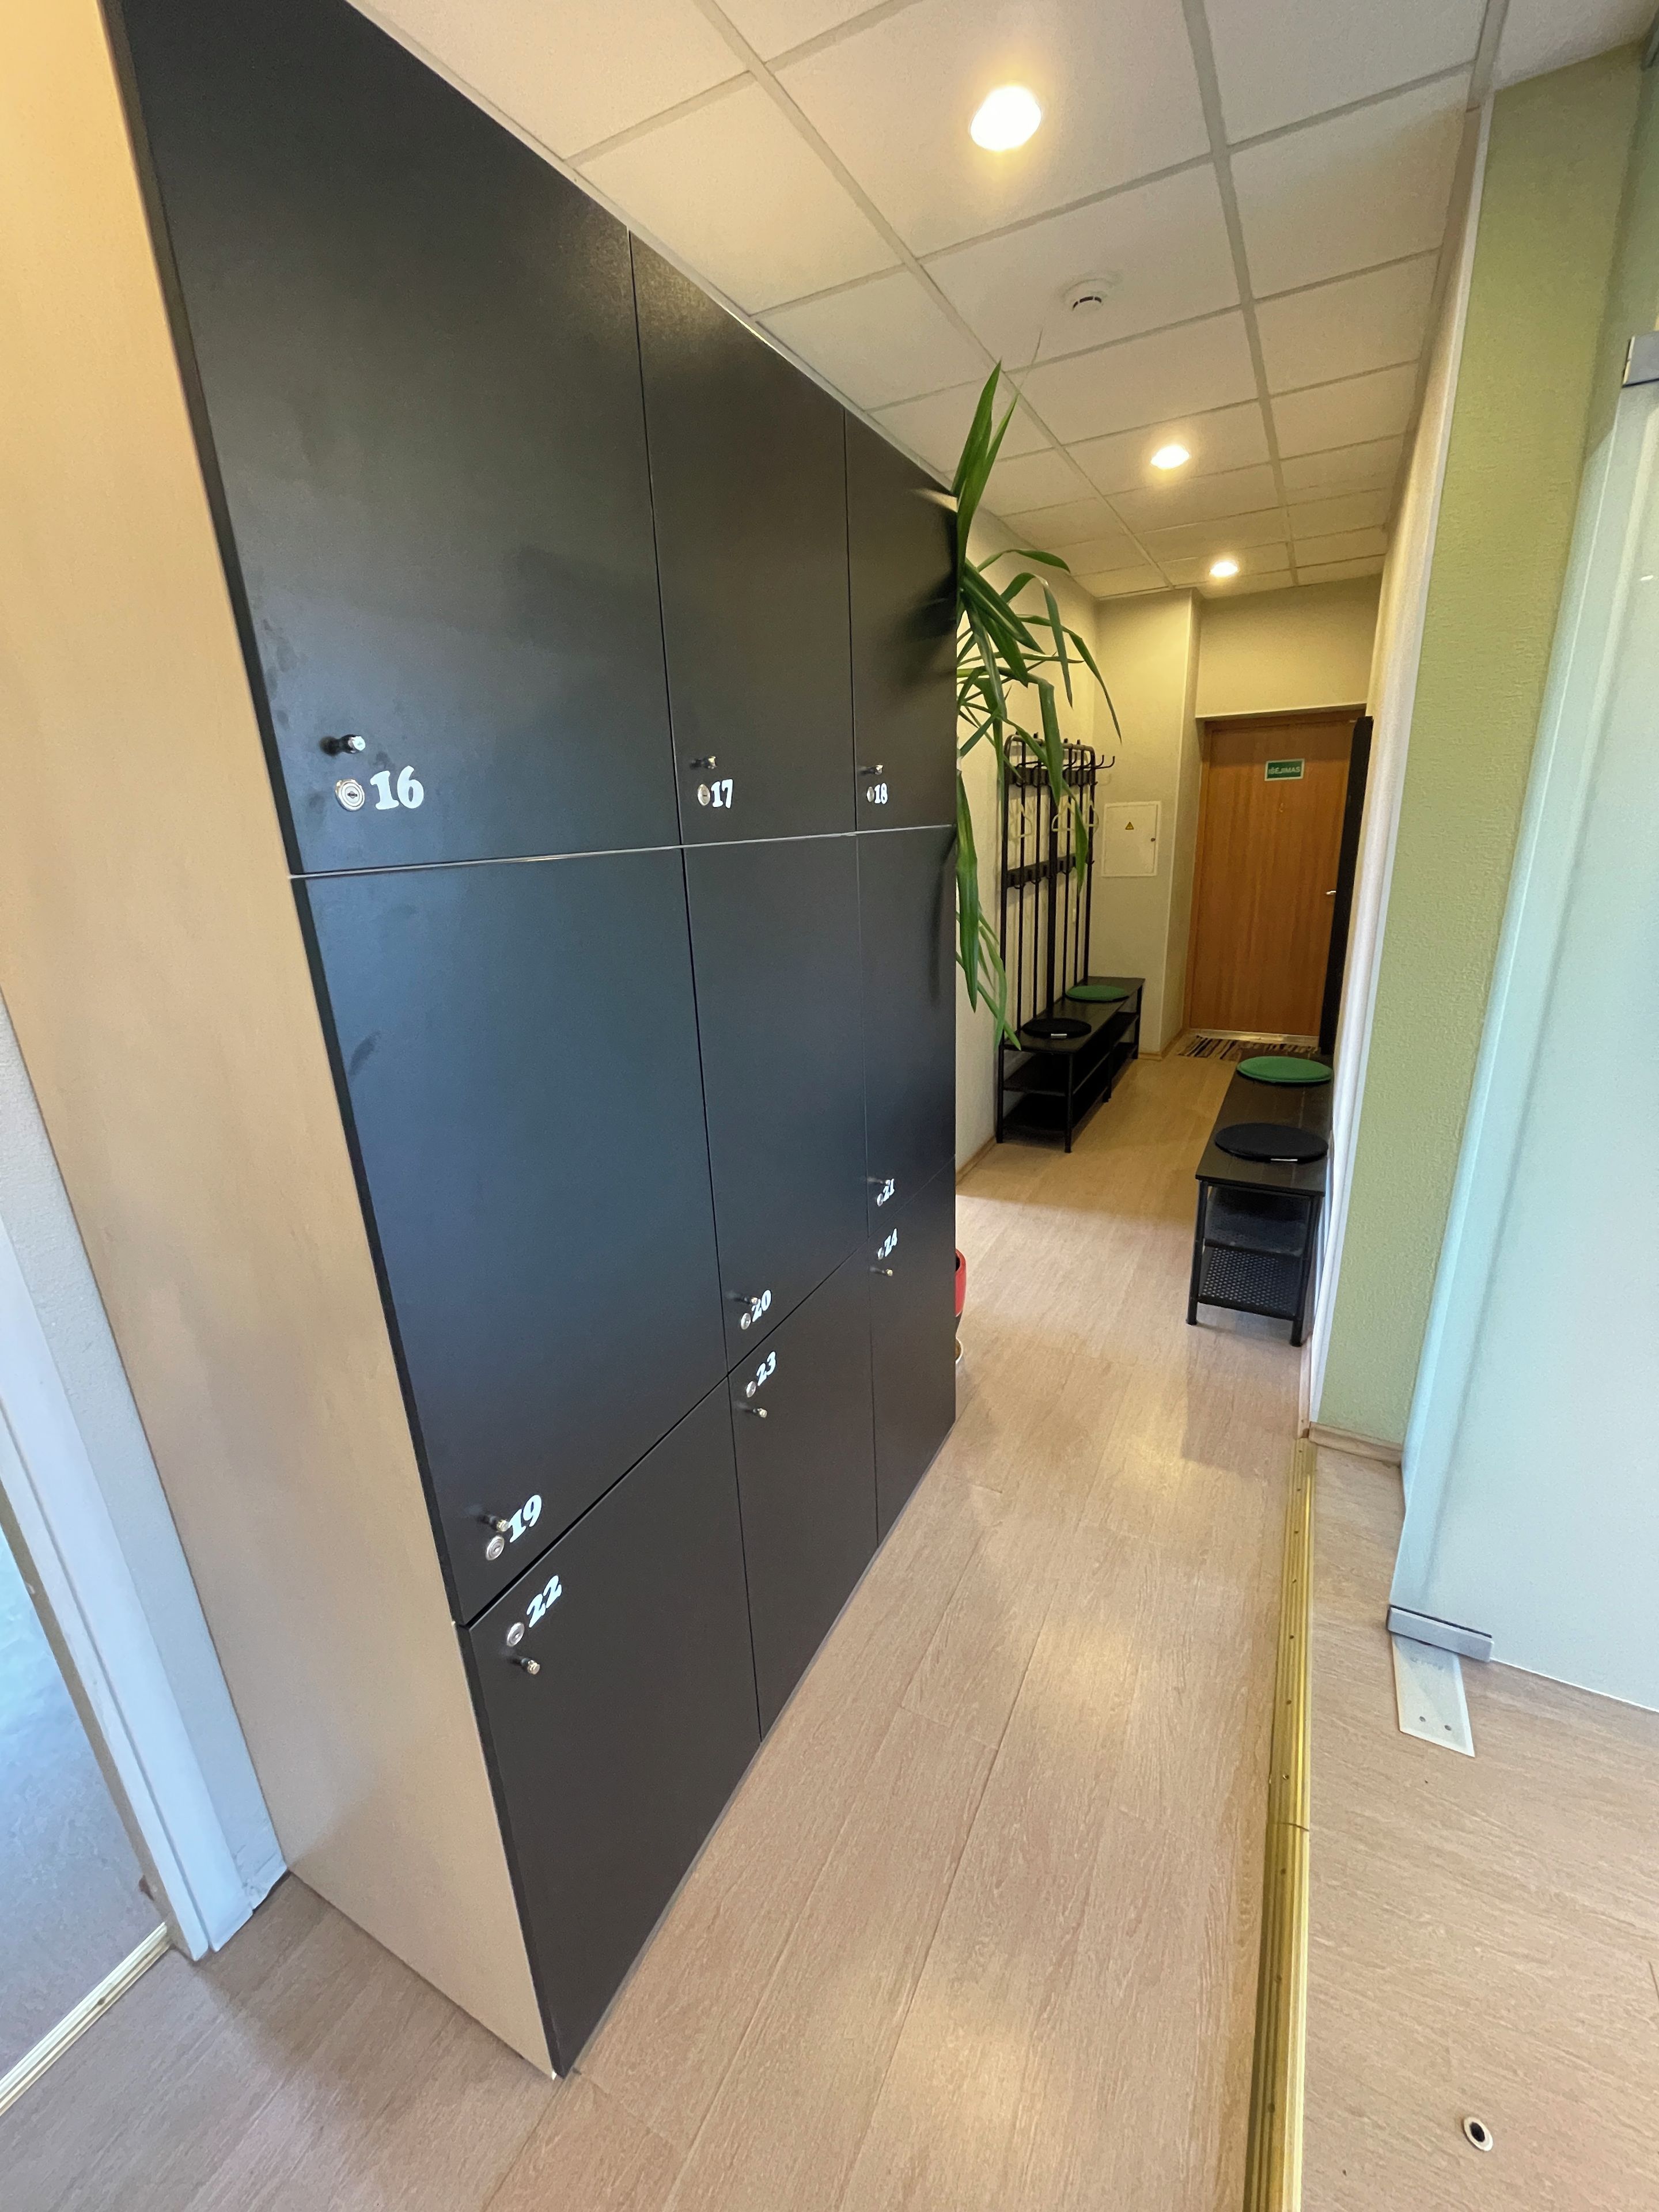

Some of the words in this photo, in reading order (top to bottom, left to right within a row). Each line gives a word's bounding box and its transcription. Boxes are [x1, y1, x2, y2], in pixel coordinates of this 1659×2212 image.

[370, 765, 425, 810] 16
[711, 779, 733, 808] 17
[874, 782, 888, 805] 18
[882, 1179, 895, 1202] 21
[884, 1229, 897, 1257] 24
[751, 1290, 771, 1323] 20
[756, 1351, 776, 1387] 23
[508, 1494, 542, 1543] 19
[526, 1575, 562, 1628] 22
